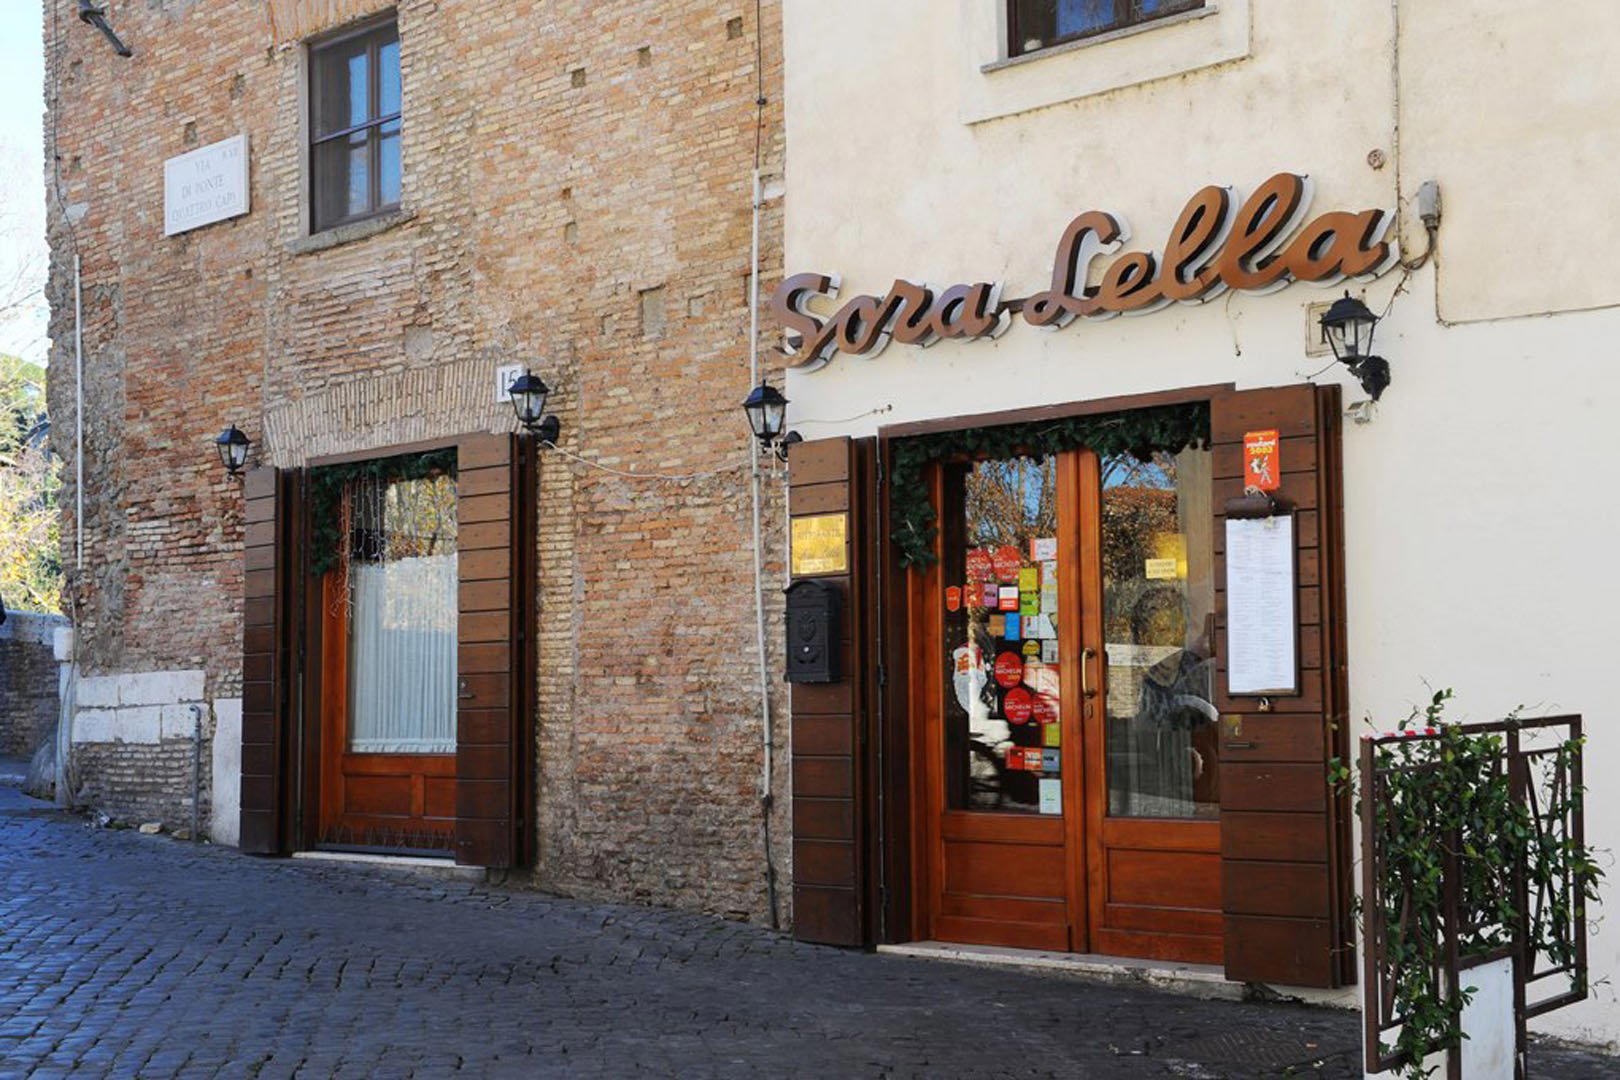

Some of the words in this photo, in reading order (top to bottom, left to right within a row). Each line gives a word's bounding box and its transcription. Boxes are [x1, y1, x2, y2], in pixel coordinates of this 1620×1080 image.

[194, 160, 211, 173] VIA
[767, 271, 1006, 373] Sora
[1022, 172, 1395, 327] Lella
